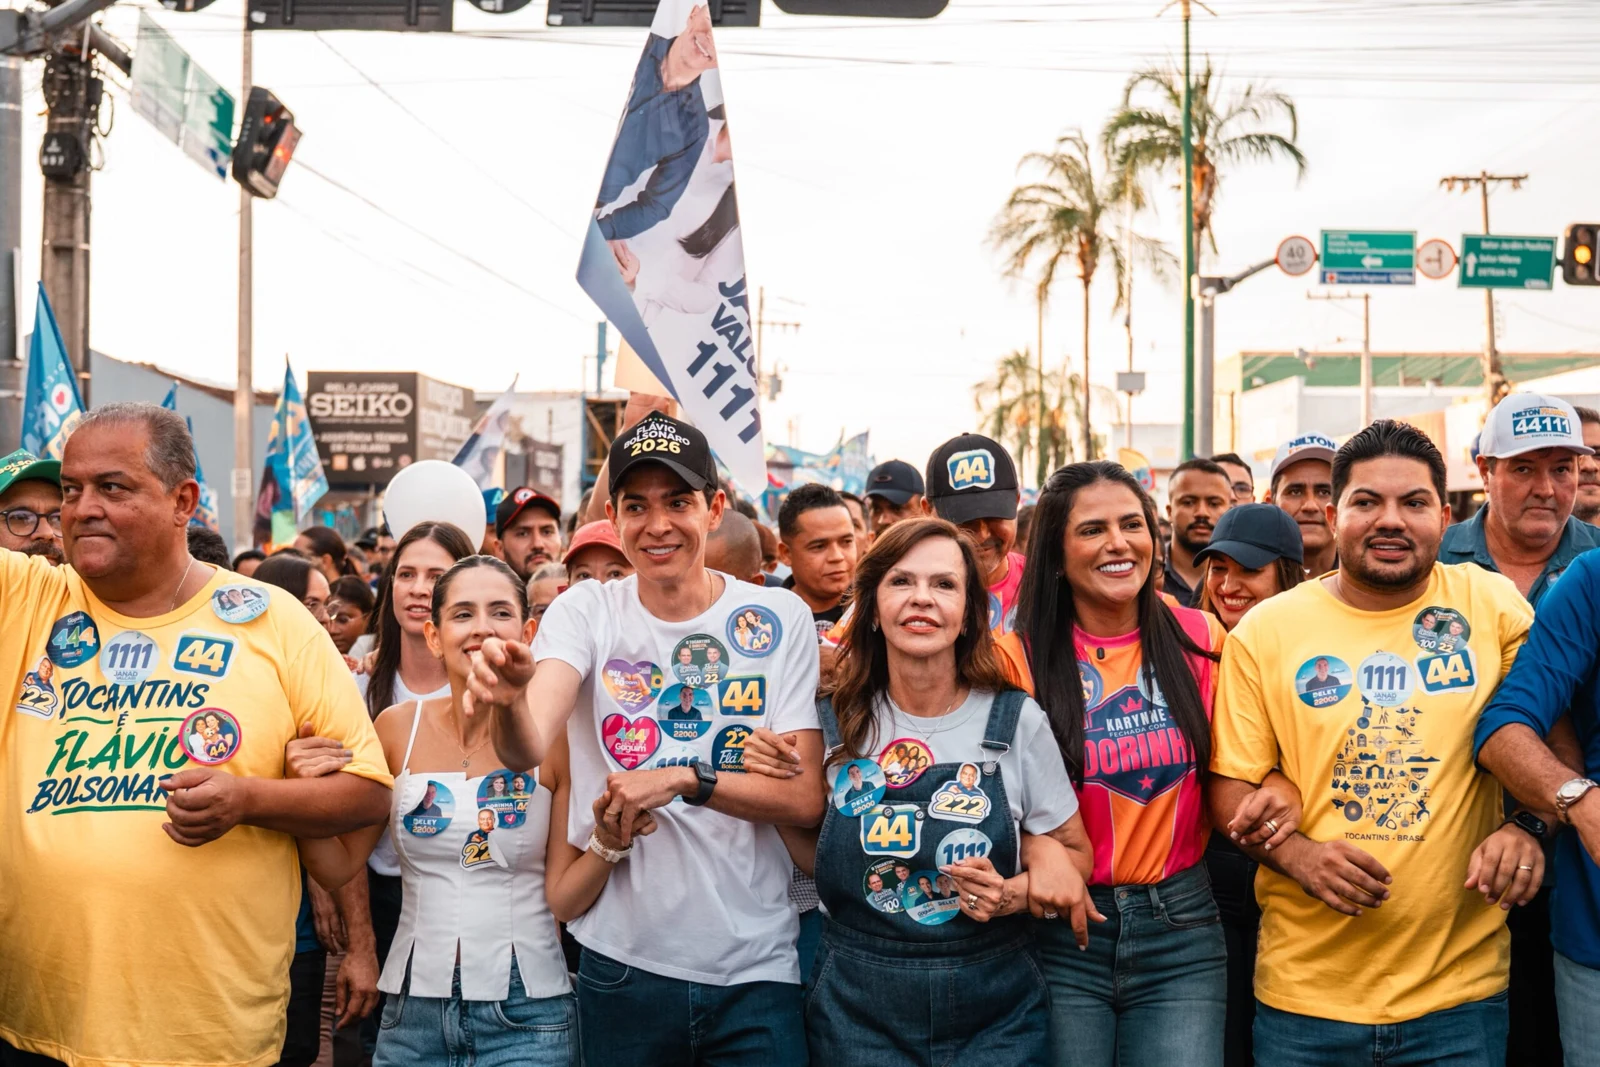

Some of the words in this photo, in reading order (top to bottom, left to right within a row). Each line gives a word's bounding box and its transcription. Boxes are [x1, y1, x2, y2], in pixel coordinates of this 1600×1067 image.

[1287, 245, 1305, 258] 40
[310, 392, 414, 418] SEIKO
[636, 421, 677, 436] FLÁVIO
[1515, 416, 1570, 433] 44111
[624, 429, 690, 450] BOLSONARO
[630, 438, 682, 457] 2026
[1289, 436, 1336, 449] NILTON
[954, 456, 988, 483] 44
[52, 626, 96, 649] 444
[752, 632, 770, 650] 44
[1420, 639, 1436, 648] 100
[108, 643, 153, 668] 1111
[179, 640, 225, 672] 44
[1364, 665, 1406, 690] 1111
[1426, 654, 1470, 686] 44
[685, 675, 701, 685] 100
[704, 673, 719, 683] 22
[60, 677, 209, 719] TOCANTINS
[618, 690, 643, 703] 222
[722, 680, 762, 711] 44
[1312, 688, 1337, 698] DELEY
[1314, 695, 1338, 706] 22000
[117, 711, 128, 727] É
[1106, 708, 1166, 732] KARYNNE
[616, 728, 646, 742] 444
[1109, 727, 1146, 738] FECHADA
[1148, 722, 1166, 731] COM
[615, 743, 646, 753] Gaguim
[724, 731, 749, 748] 22
[46, 726, 190, 777] FLÁVIO
[210, 742, 226, 756] 44
[26, 773, 176, 814] BOLSONAR
[851, 793, 873, 808] DELEY
[853, 800, 875, 815] 22000
[935, 794, 984, 816] 222
[867, 814, 912, 848] 44
[1345, 832, 1389, 840] TOCANTINS
[883, 898, 899, 911] 100
